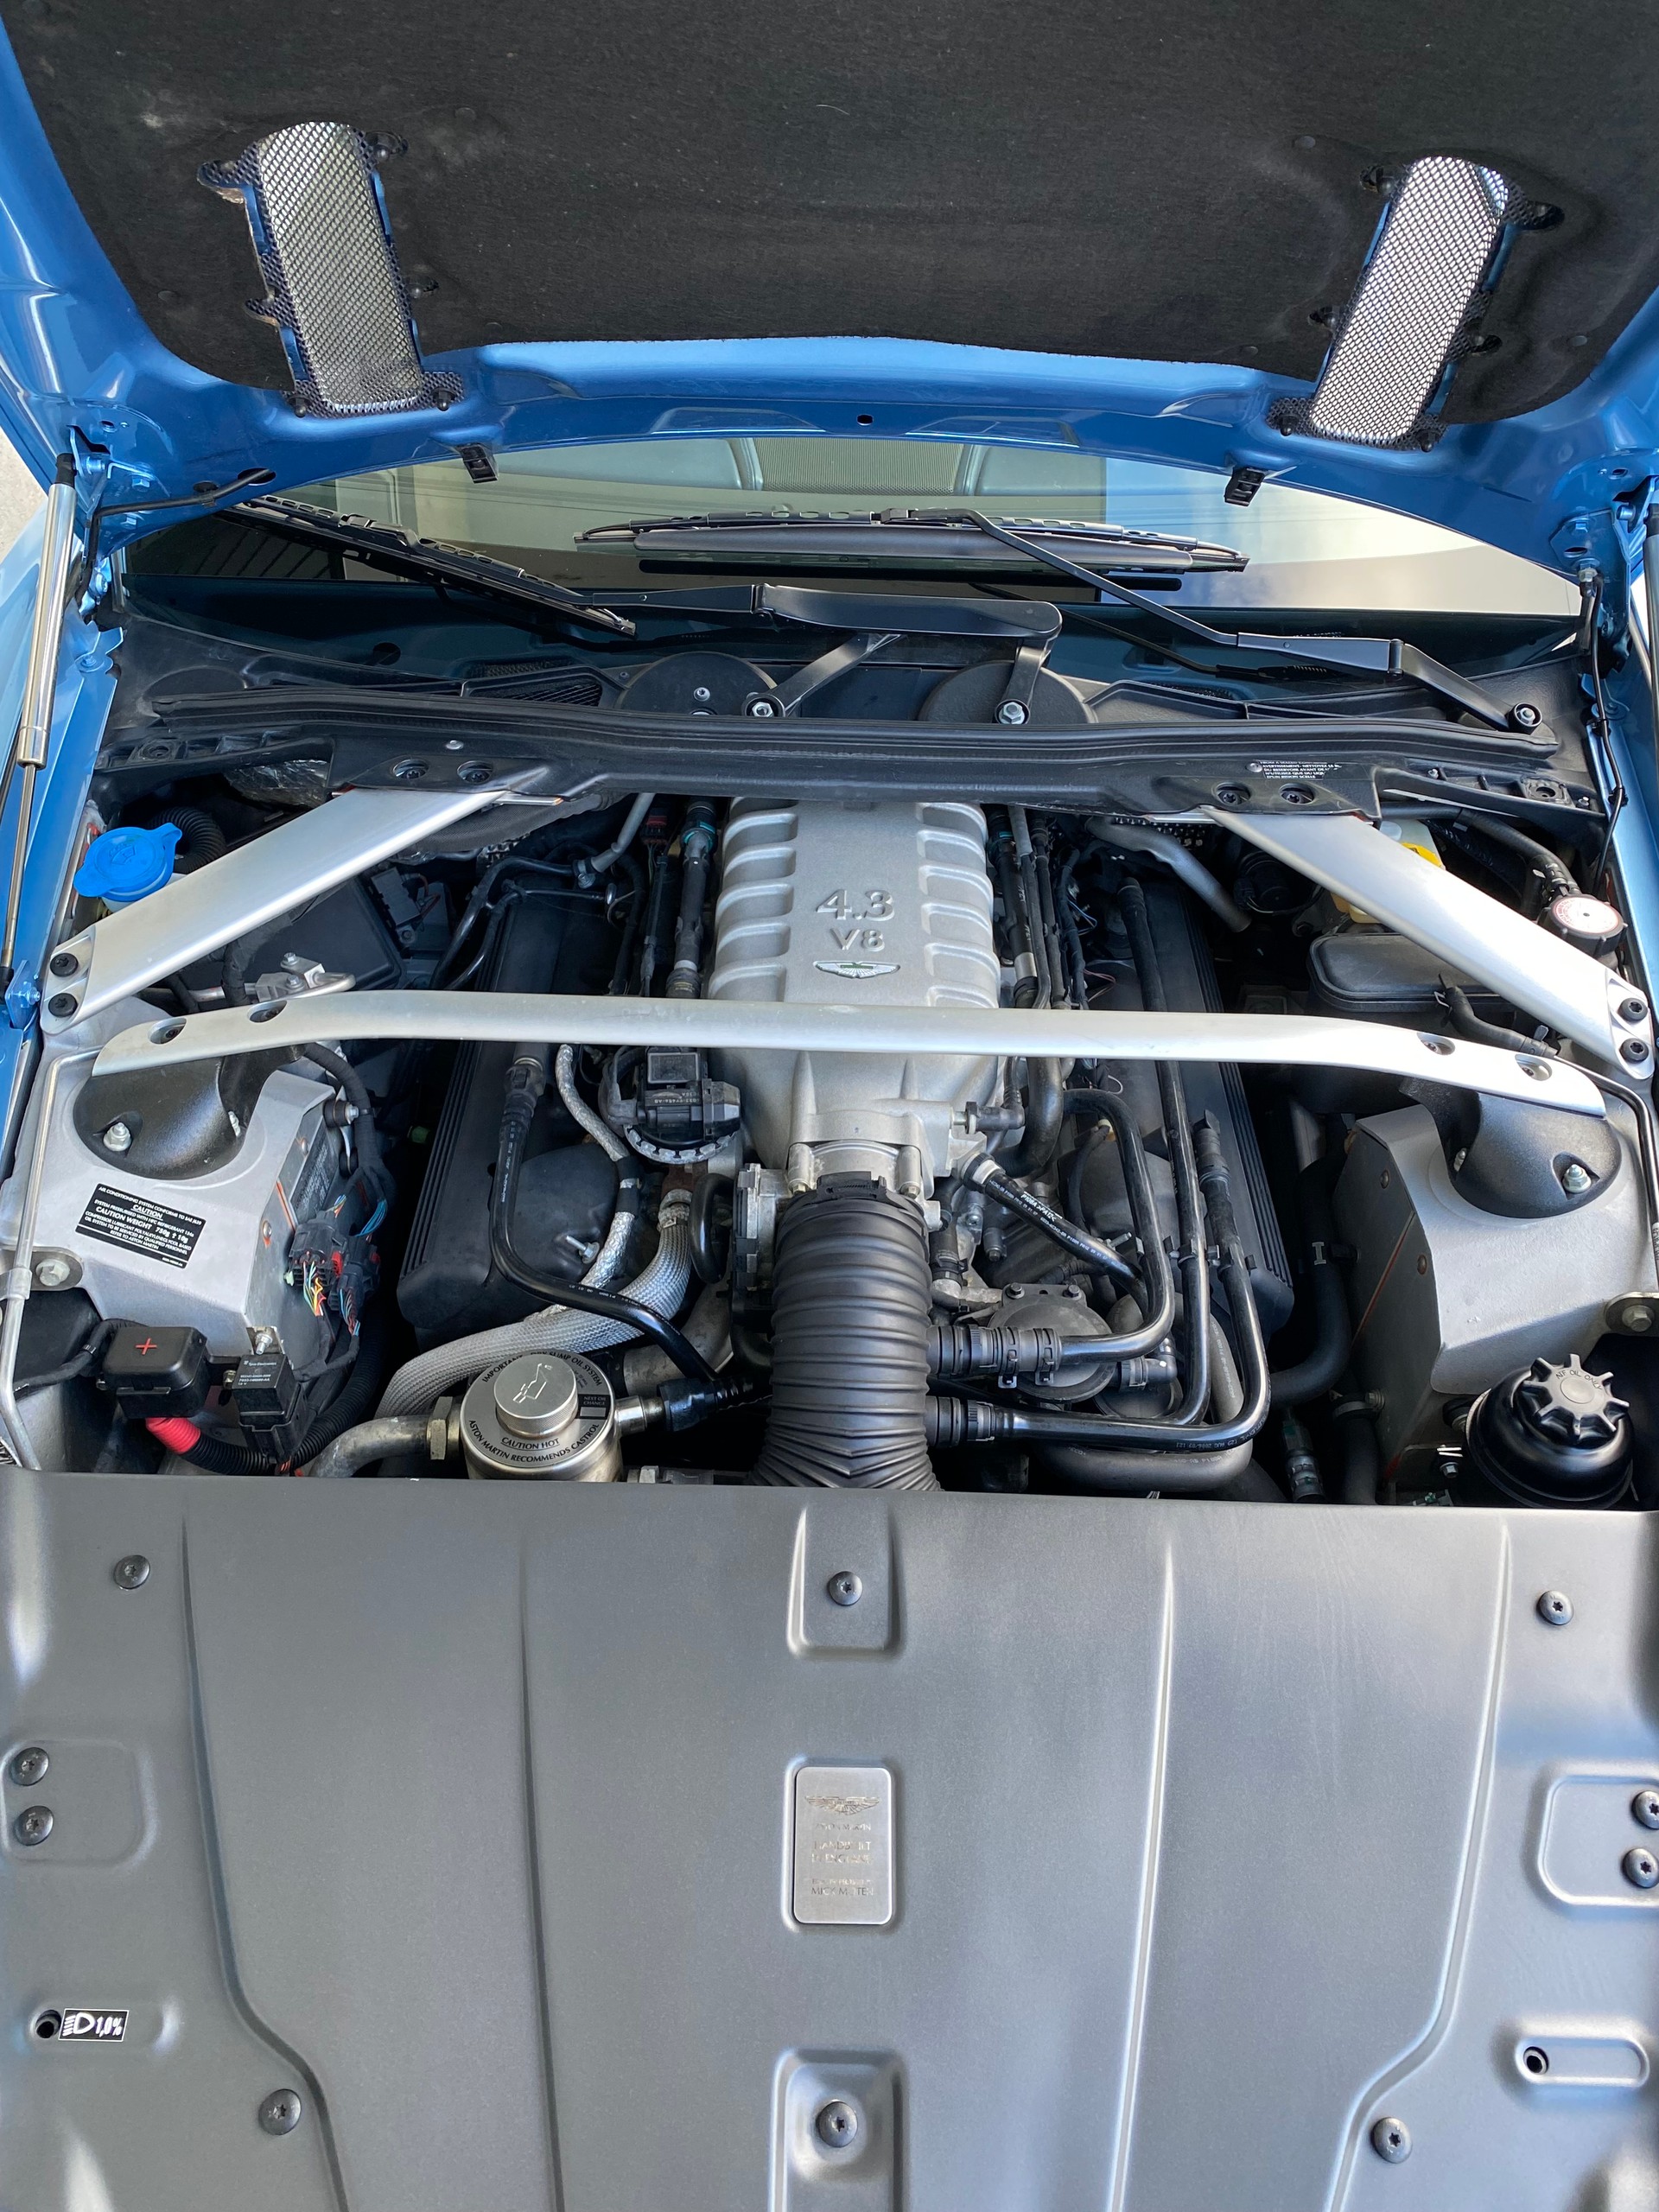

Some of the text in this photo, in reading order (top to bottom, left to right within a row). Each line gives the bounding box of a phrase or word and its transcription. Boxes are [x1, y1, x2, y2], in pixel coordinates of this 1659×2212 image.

[816, 888, 894, 921] 4.3
[830, 927, 885, 951] V8
[94, 1199, 111, 1208] SYSTEM
[106, 1190, 138, 1204] CONDITIONING
[138, 1200, 154, 1209] SYSTEM
[132, 1205, 163, 1218] CAUTION
[96, 1206, 126, 1221] CAUTION
[125, 1217, 152, 1230] WEIGHT
[177, 1235, 189, 1243] 10g
[571, 1357, 584, 1367] OIL
[582, 1364, 602, 1386] SYSTEM
[1584, 1375, 1602, 1389] ONLY
[469, 1420, 599, 1462] ASTON MARTIN RECOMMENDS CASTROL
[501, 1437, 559, 1449] CAUTION HOT
[814, 1840, 871, 1850] HANDBILT
[811, 1886, 873, 1896] MICK MTEN
